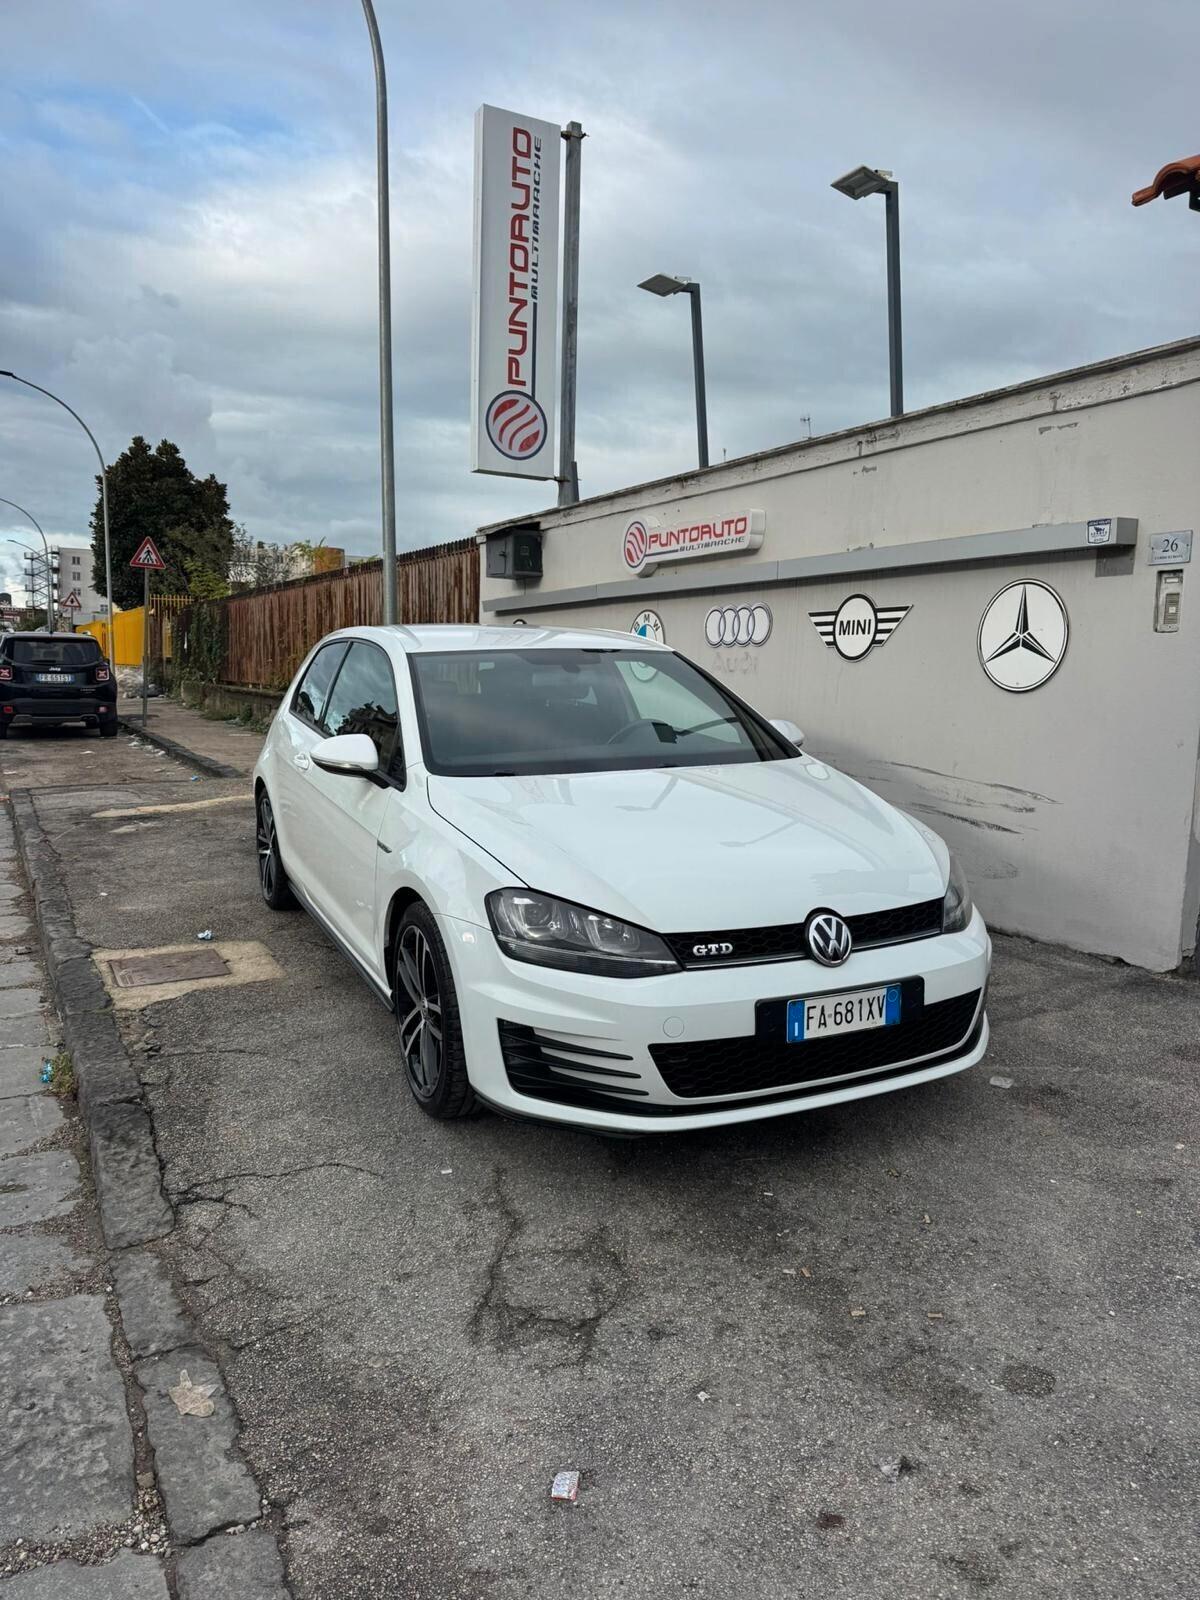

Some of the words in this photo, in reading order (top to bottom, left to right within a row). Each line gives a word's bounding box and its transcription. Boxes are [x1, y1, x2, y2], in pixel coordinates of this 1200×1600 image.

[531, 136, 542, 301] MULTIMARCHE
[508, 127, 531, 386] PUNTOAUTO
[648, 517, 747, 549] PUNTOAUTO
[1162, 538, 1178, 553] 26
[634, 614, 661, 633] BMW
[839, 619, 871, 635] MINI
[693, 943, 733, 956] GTD
